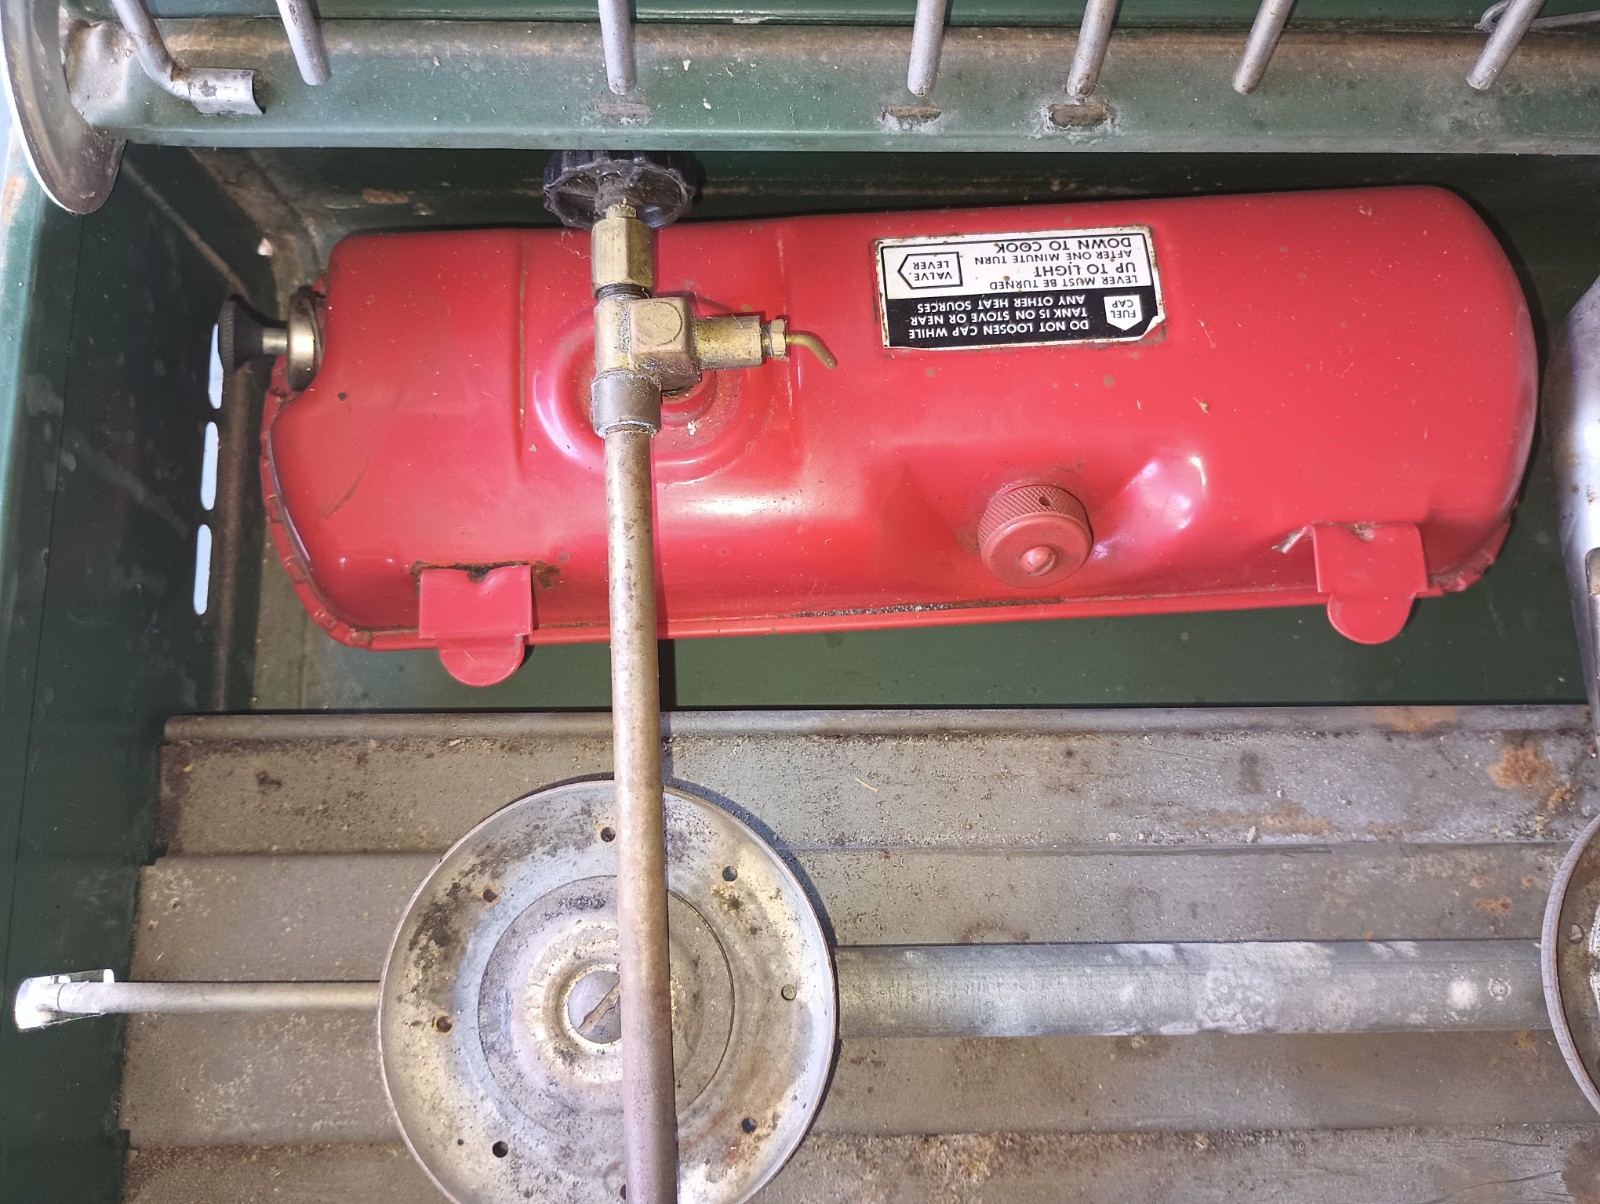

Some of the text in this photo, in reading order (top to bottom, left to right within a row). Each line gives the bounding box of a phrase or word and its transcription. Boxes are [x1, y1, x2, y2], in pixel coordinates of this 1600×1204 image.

[995, 237, 1131, 254] DOWN TO COOK
[912, 260, 949, 270] LEVER
[975, 250, 1132, 266] AFTER ONE MINUTE TURN
[912, 271, 952, 281] VALVE
[1033, 262, 1136, 277] UP TO LIGHT
[989, 275, 1137, 290] LEVER MUST BE TURNED
[917, 295, 1085, 314] ANY OTHER HEAT SOURCES
[1111, 299, 1134, 309] CAP
[910, 307, 1087, 327] TANK IS ON STOVE OR NEAR
[1110, 309, 1136, 319] FUEL
[908, 319, 1089, 340] DO NOT LOOSEN CAP WHILE
